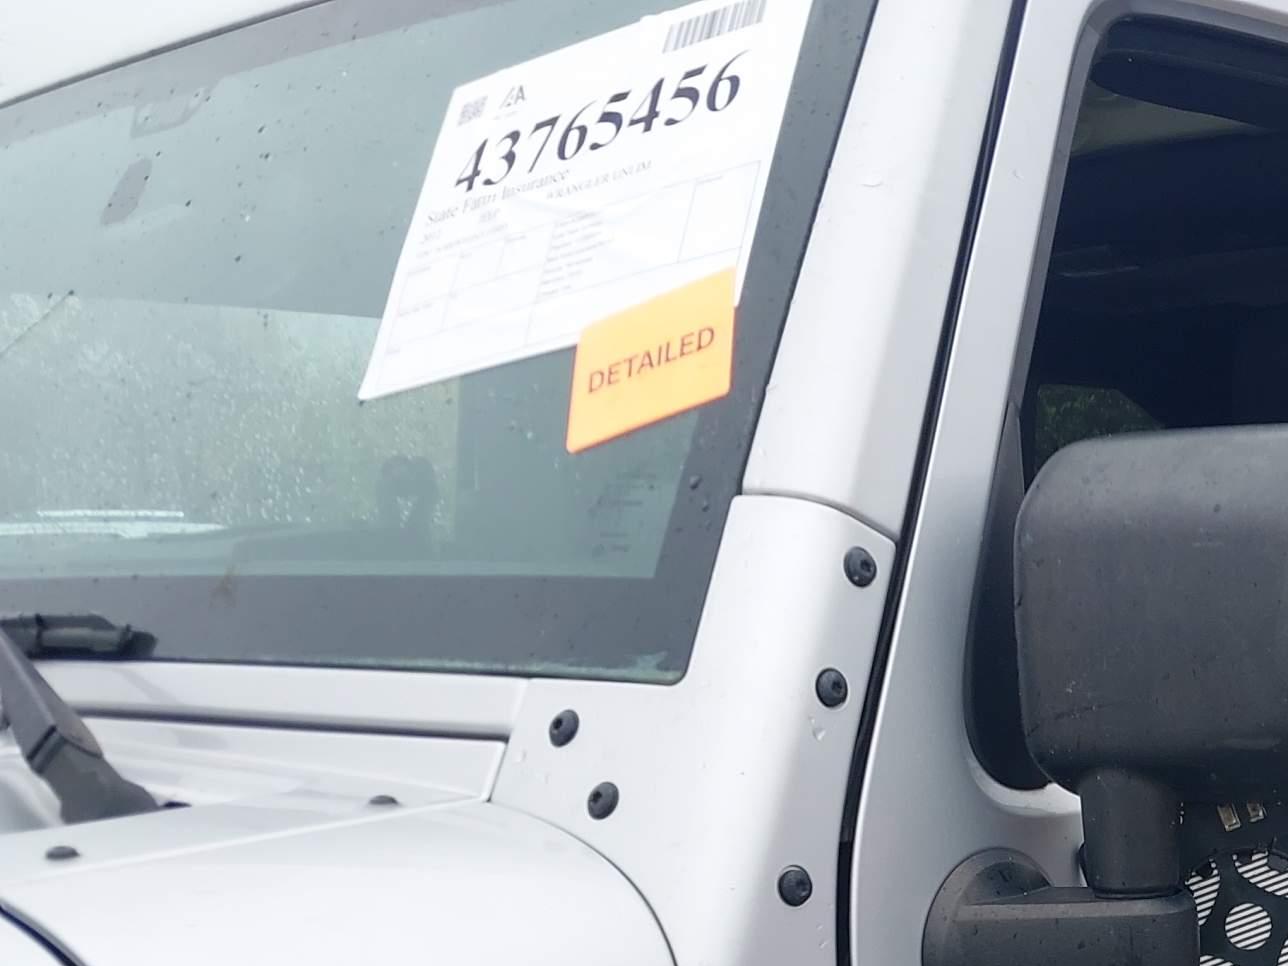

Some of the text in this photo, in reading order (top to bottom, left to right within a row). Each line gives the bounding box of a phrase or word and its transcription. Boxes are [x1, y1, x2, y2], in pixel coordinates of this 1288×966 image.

[454, 49, 750, 194] 43765456
[501, 169, 571, 200] Insurance
[588, 326, 715, 395] DETAILED
